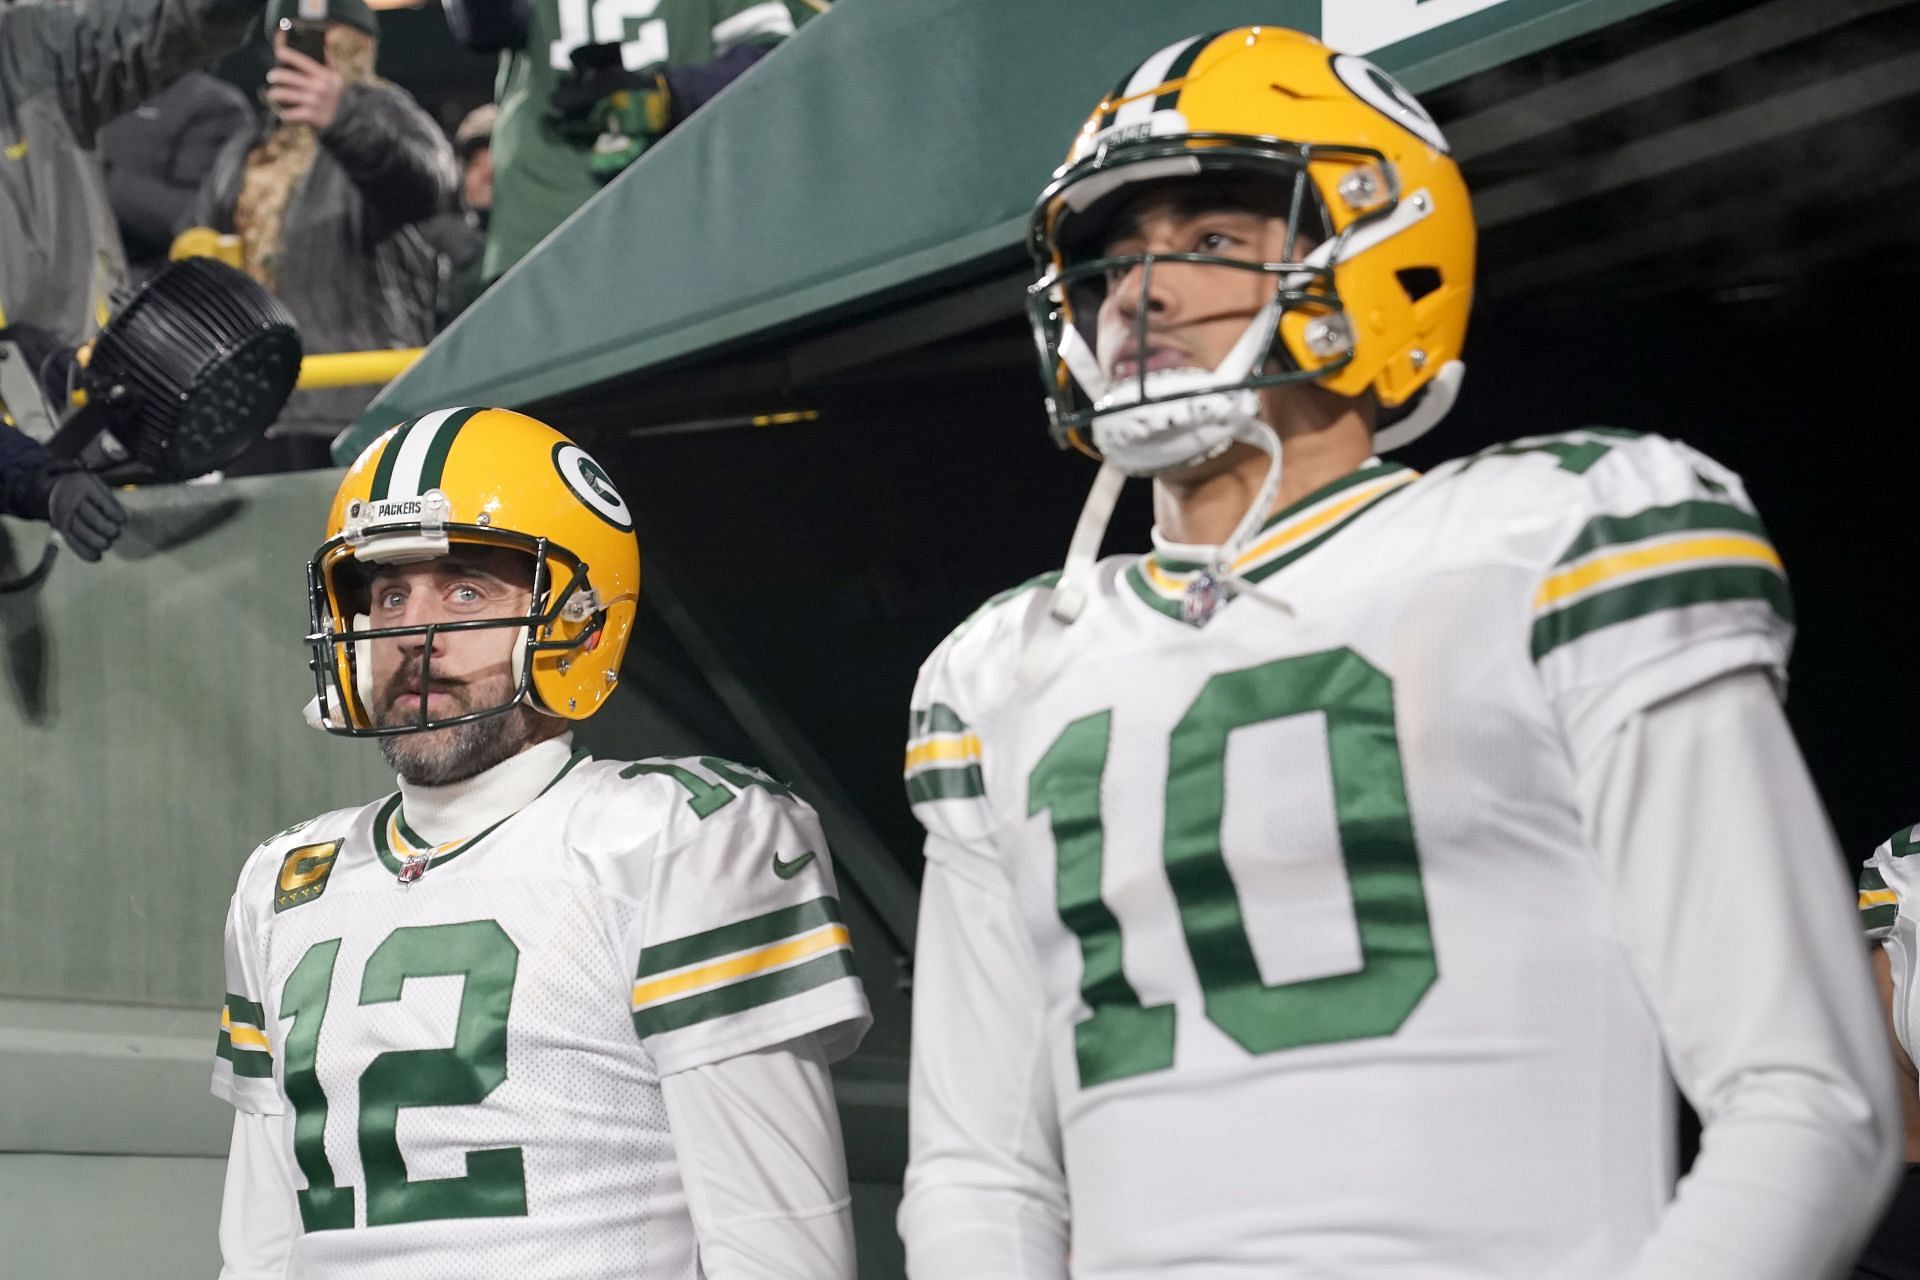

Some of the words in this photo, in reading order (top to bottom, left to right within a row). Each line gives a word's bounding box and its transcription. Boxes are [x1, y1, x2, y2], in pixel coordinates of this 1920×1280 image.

[378, 501, 421, 517] PACKERS
[280, 842, 337, 892] C
[1027, 646, 1439, 1090] 10
[278, 918, 528, 1234] 12
